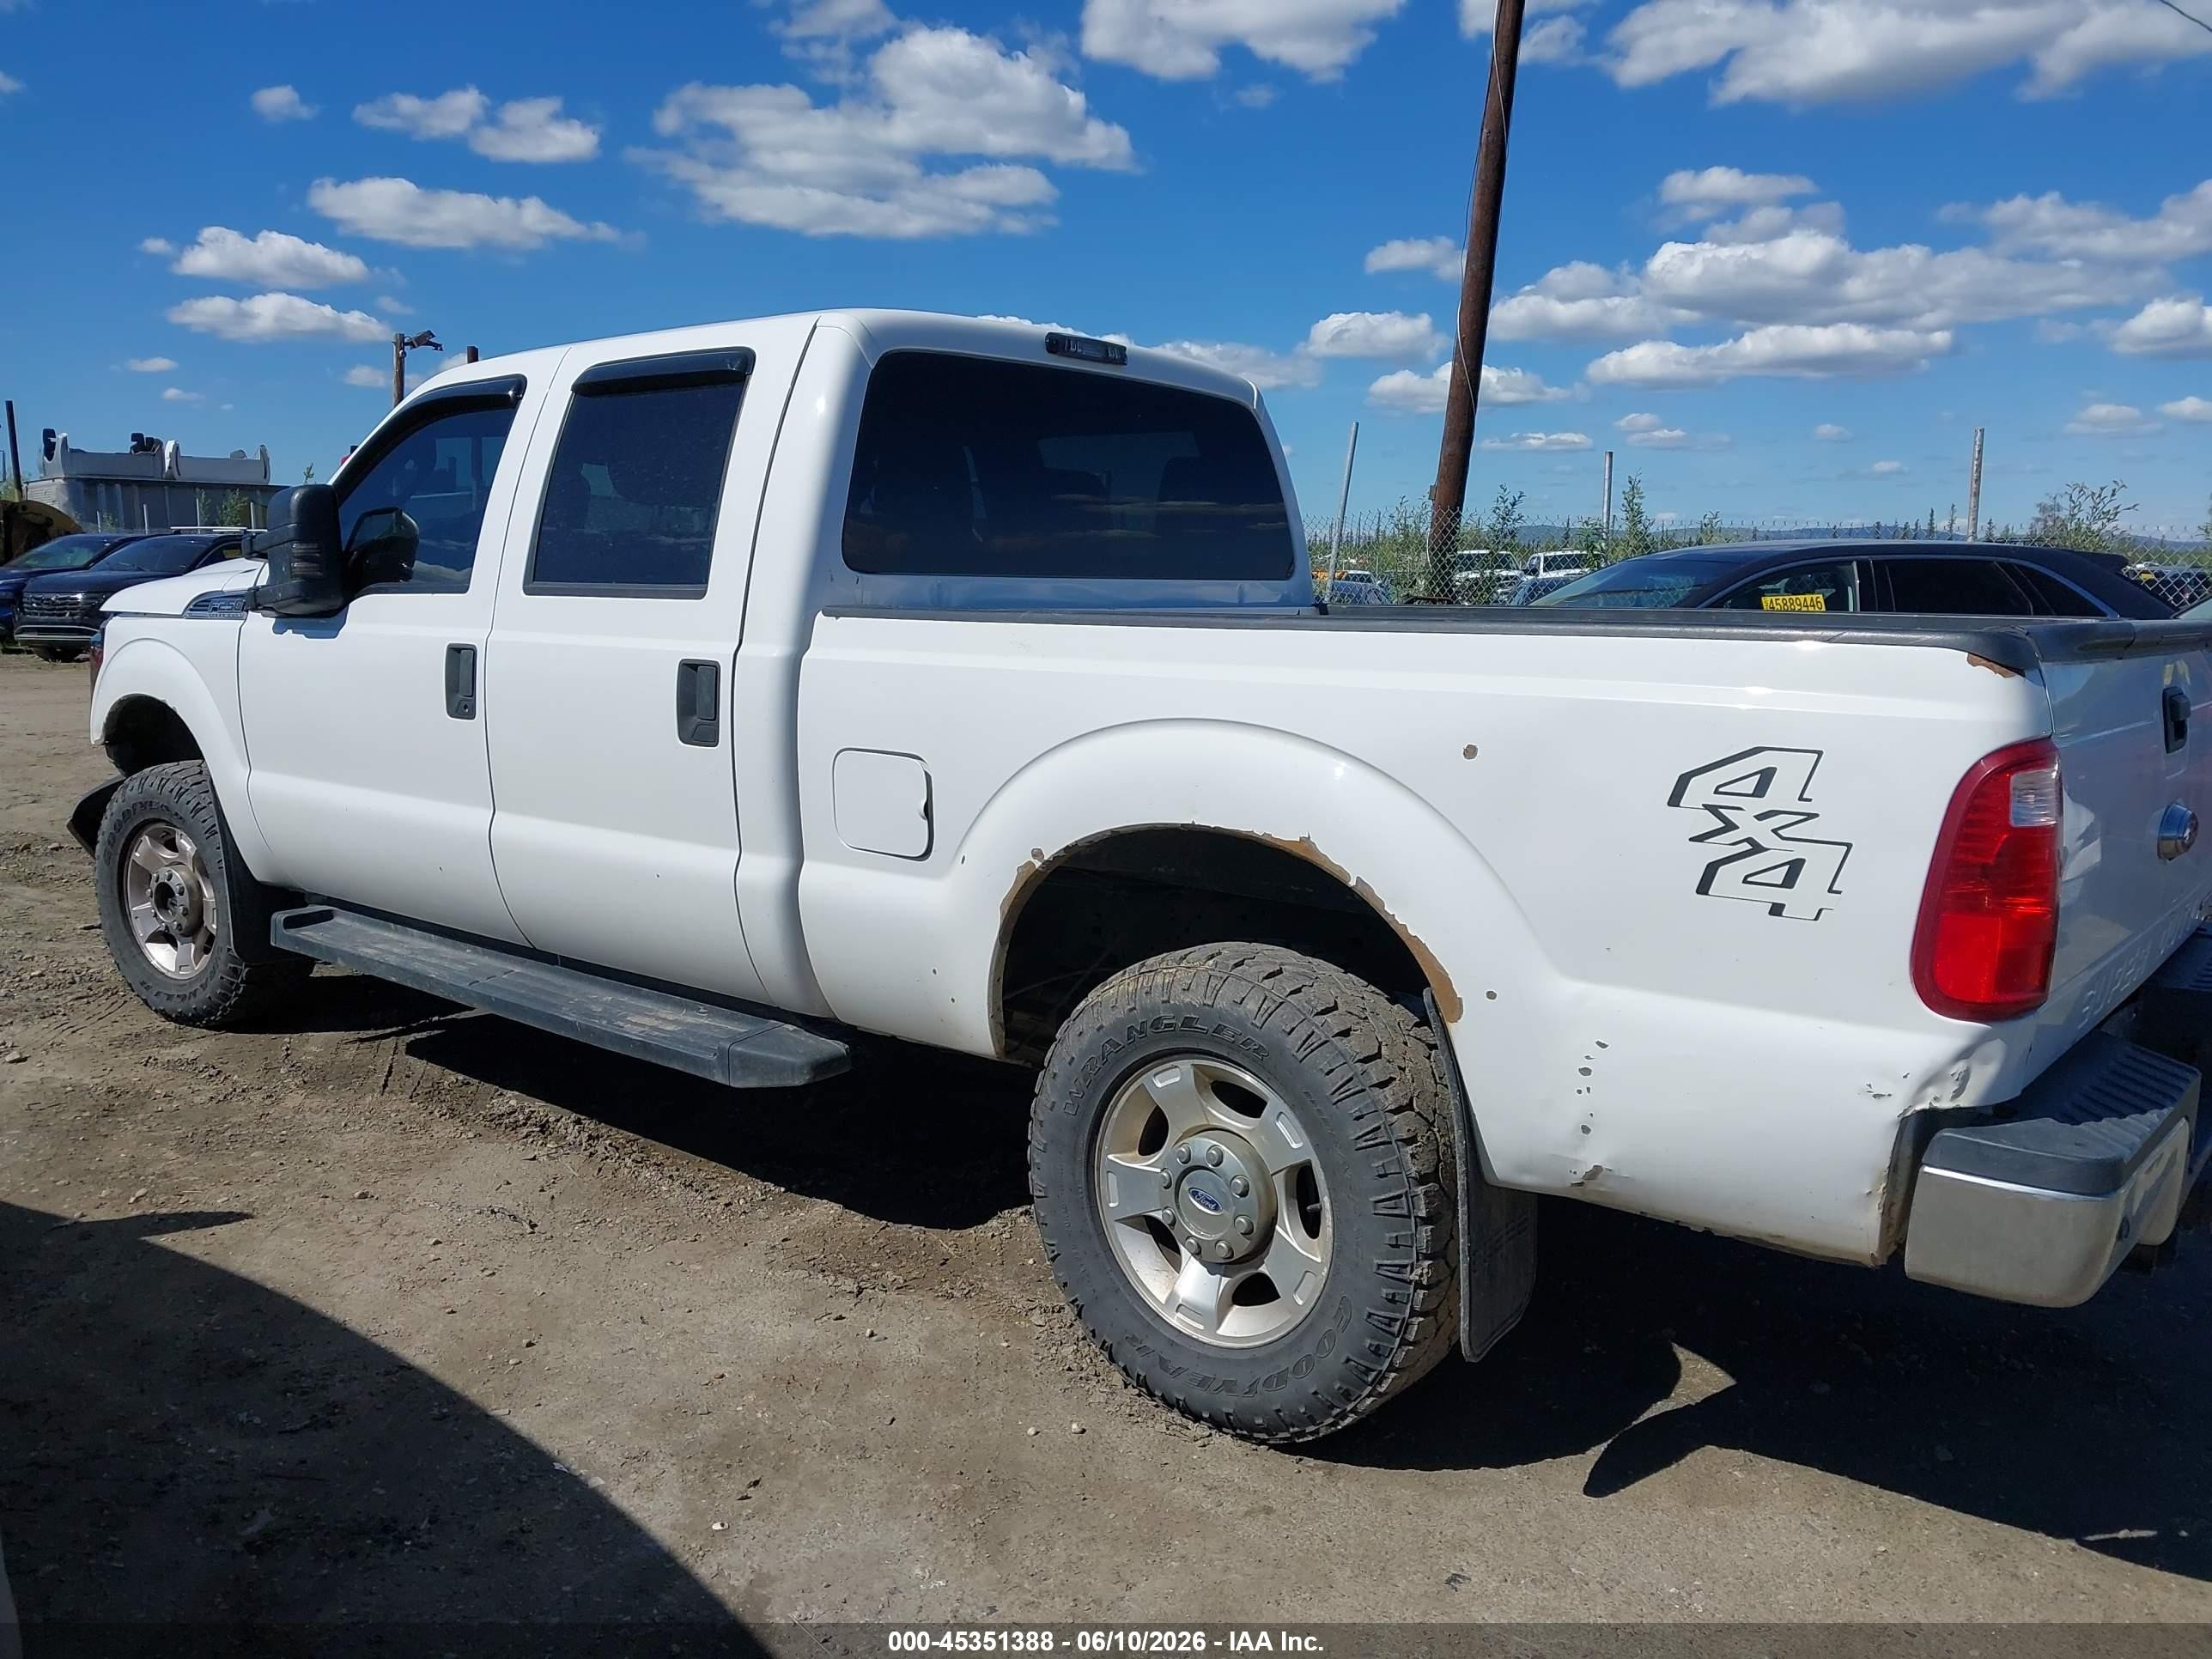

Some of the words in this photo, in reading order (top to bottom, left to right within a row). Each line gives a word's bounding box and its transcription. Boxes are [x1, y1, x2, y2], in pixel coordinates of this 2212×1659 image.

[1769, 596, 1823, 611] 45889446
[1064, 1014, 1270, 1116] WRANGLER
[1194, 1192, 1217, 1210] Ford
[1125, 1295, 1352, 1398] GOODYEAR
